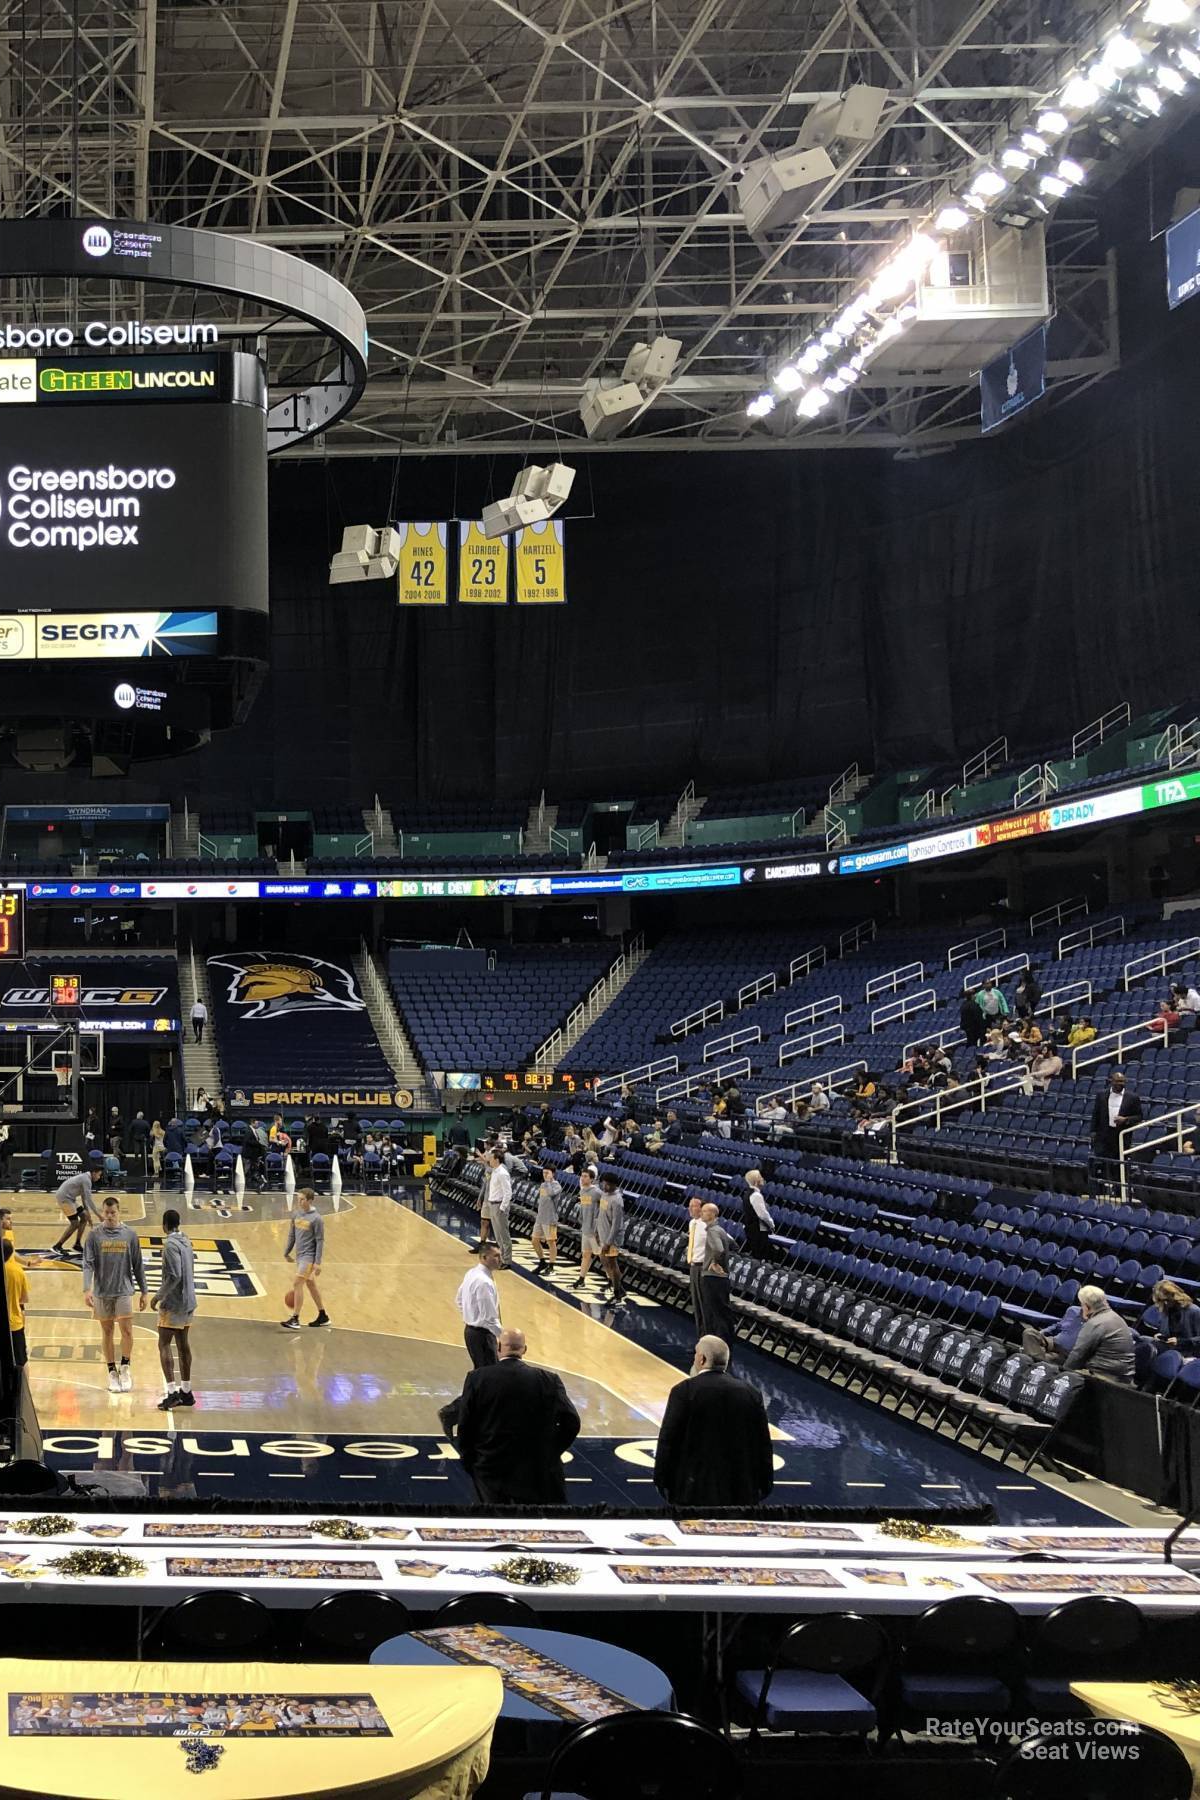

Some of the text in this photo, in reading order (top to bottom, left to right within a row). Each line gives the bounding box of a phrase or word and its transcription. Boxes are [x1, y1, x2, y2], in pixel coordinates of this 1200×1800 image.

[84, 322, 218, 345] Coliseum
[40, 369, 214, 391] GREEN LINCOLN
[8, 464, 176, 491] Greensboro
[8, 493, 140, 519] Coliseum
[8, 521, 139, 551] Complex
[412, 546, 433, 556] HINES
[410, 560, 435, 586] 42
[471, 558, 496, 585] 23
[535, 558, 546, 584] 5
[41, 624, 140, 640] SEGRA
[1154, 780, 1188, 804] TFA
[1061, 803, 1095, 823] BRADY
[993, 818, 1023, 833] southwest
[765, 863, 820, 879] CARCOBRAS.COM
[402, 881, 472, 894] DO THE DEW
[53, 978, 78, 987] 38:13
[526, 1074, 552, 1085] 38:13
[253, 1092, 392, 1105] SPARTAN CLUB
[56, 1152, 83, 1162] TFA
